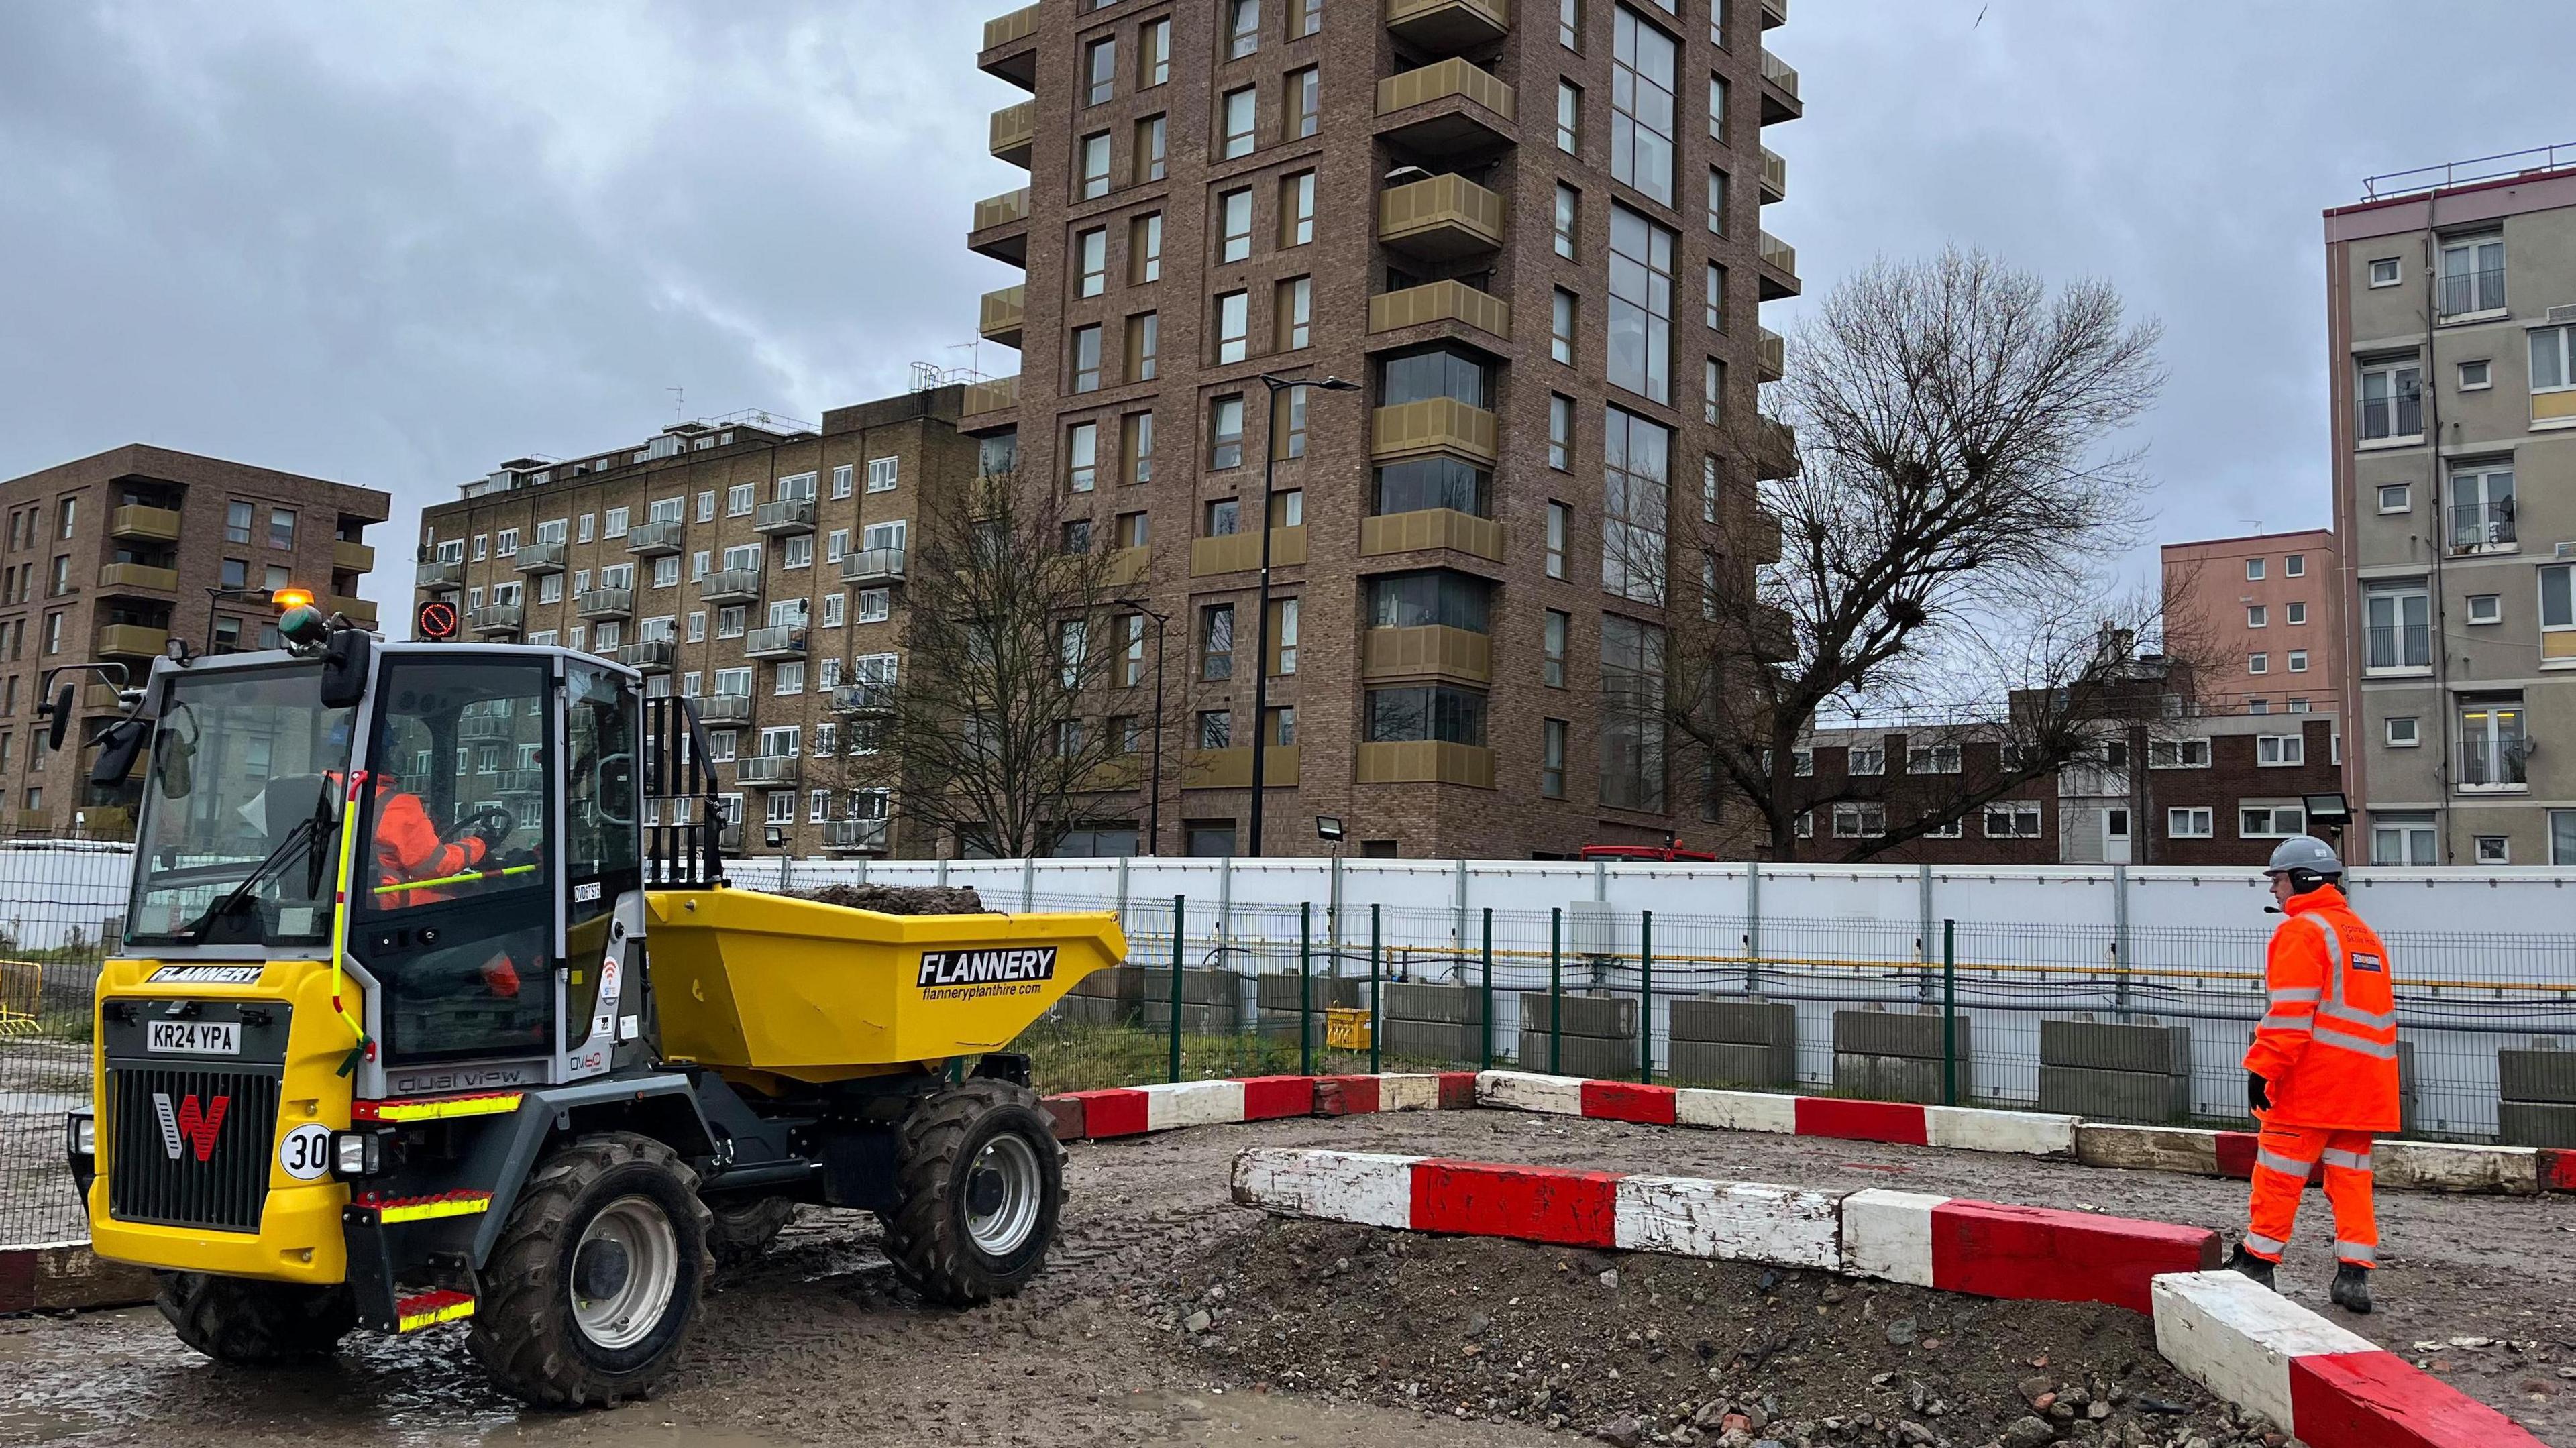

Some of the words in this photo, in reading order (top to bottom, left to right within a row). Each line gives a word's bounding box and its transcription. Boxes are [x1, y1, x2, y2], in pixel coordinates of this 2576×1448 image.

[149, 967, 264, 982] FLANNERY
[920, 949, 1054, 984] FLANNERY
[922, 983, 1042, 1001] flanneryplanthirecom
[154, 1024, 195, 1048] KR24
[201, 1025, 232, 1050] YPA
[289, 1134, 327, 1170] 30
